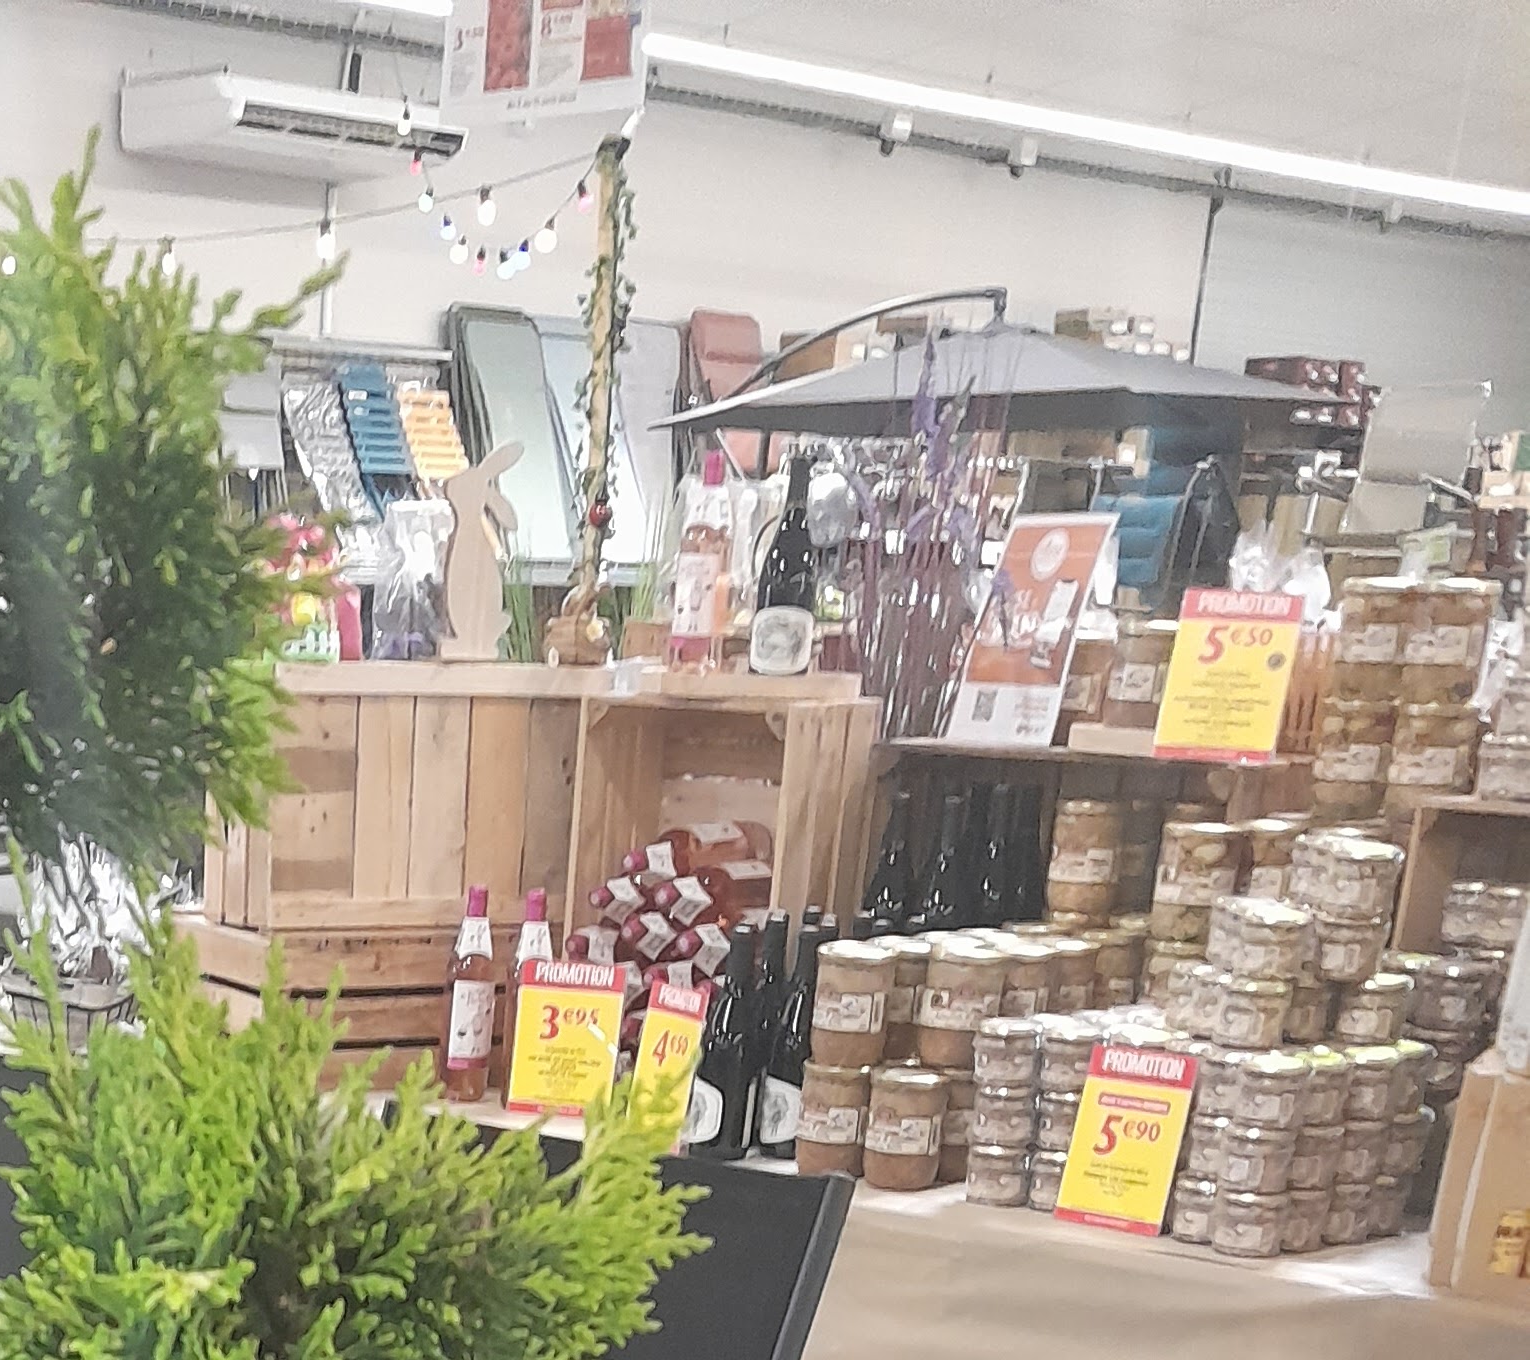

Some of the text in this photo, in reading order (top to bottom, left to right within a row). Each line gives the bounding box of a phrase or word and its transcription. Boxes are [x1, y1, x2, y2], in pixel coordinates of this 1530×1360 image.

[1198, 591, 1292, 616] PROMOTION
[535, 962, 615, 987] PROMOTION
[1101, 1049, 1186, 1081] PROMOTION
